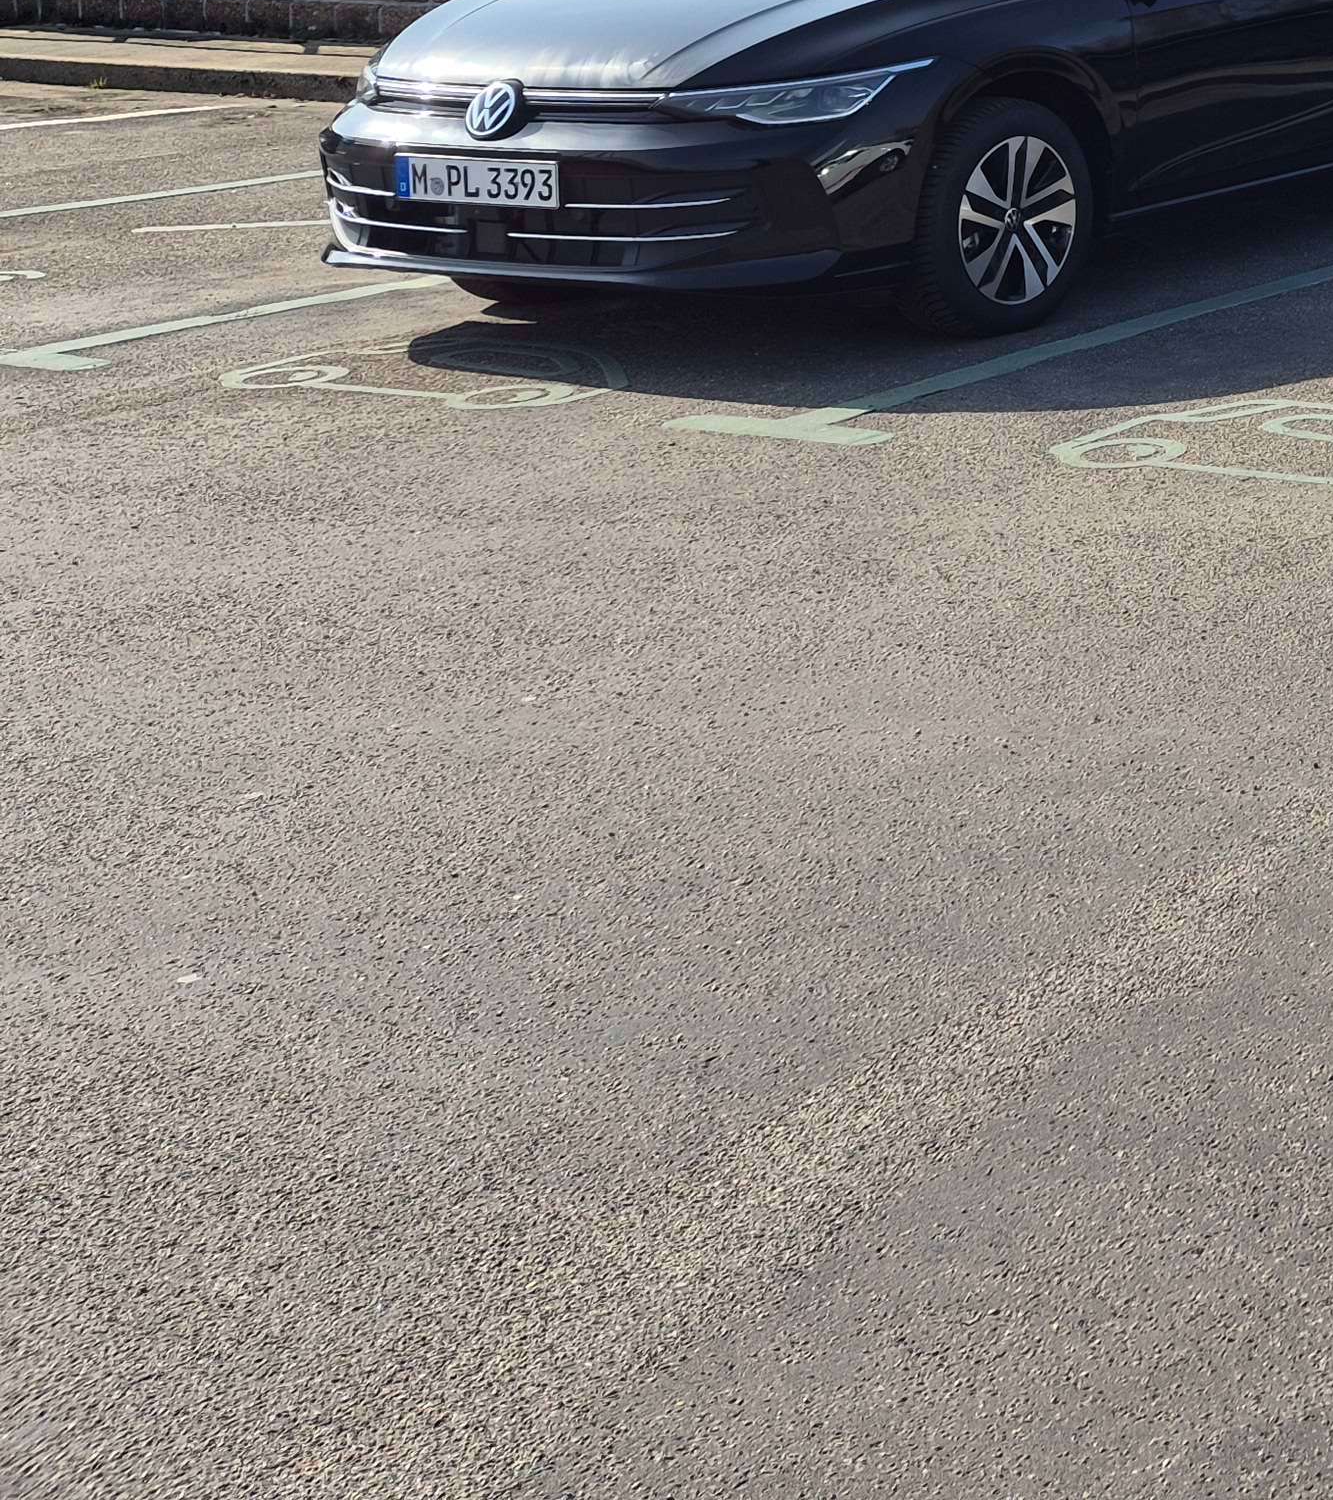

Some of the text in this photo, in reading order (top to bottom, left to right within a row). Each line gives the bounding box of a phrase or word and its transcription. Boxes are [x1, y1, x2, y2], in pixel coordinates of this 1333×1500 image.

[411, 163, 553, 201] M PL 3393
